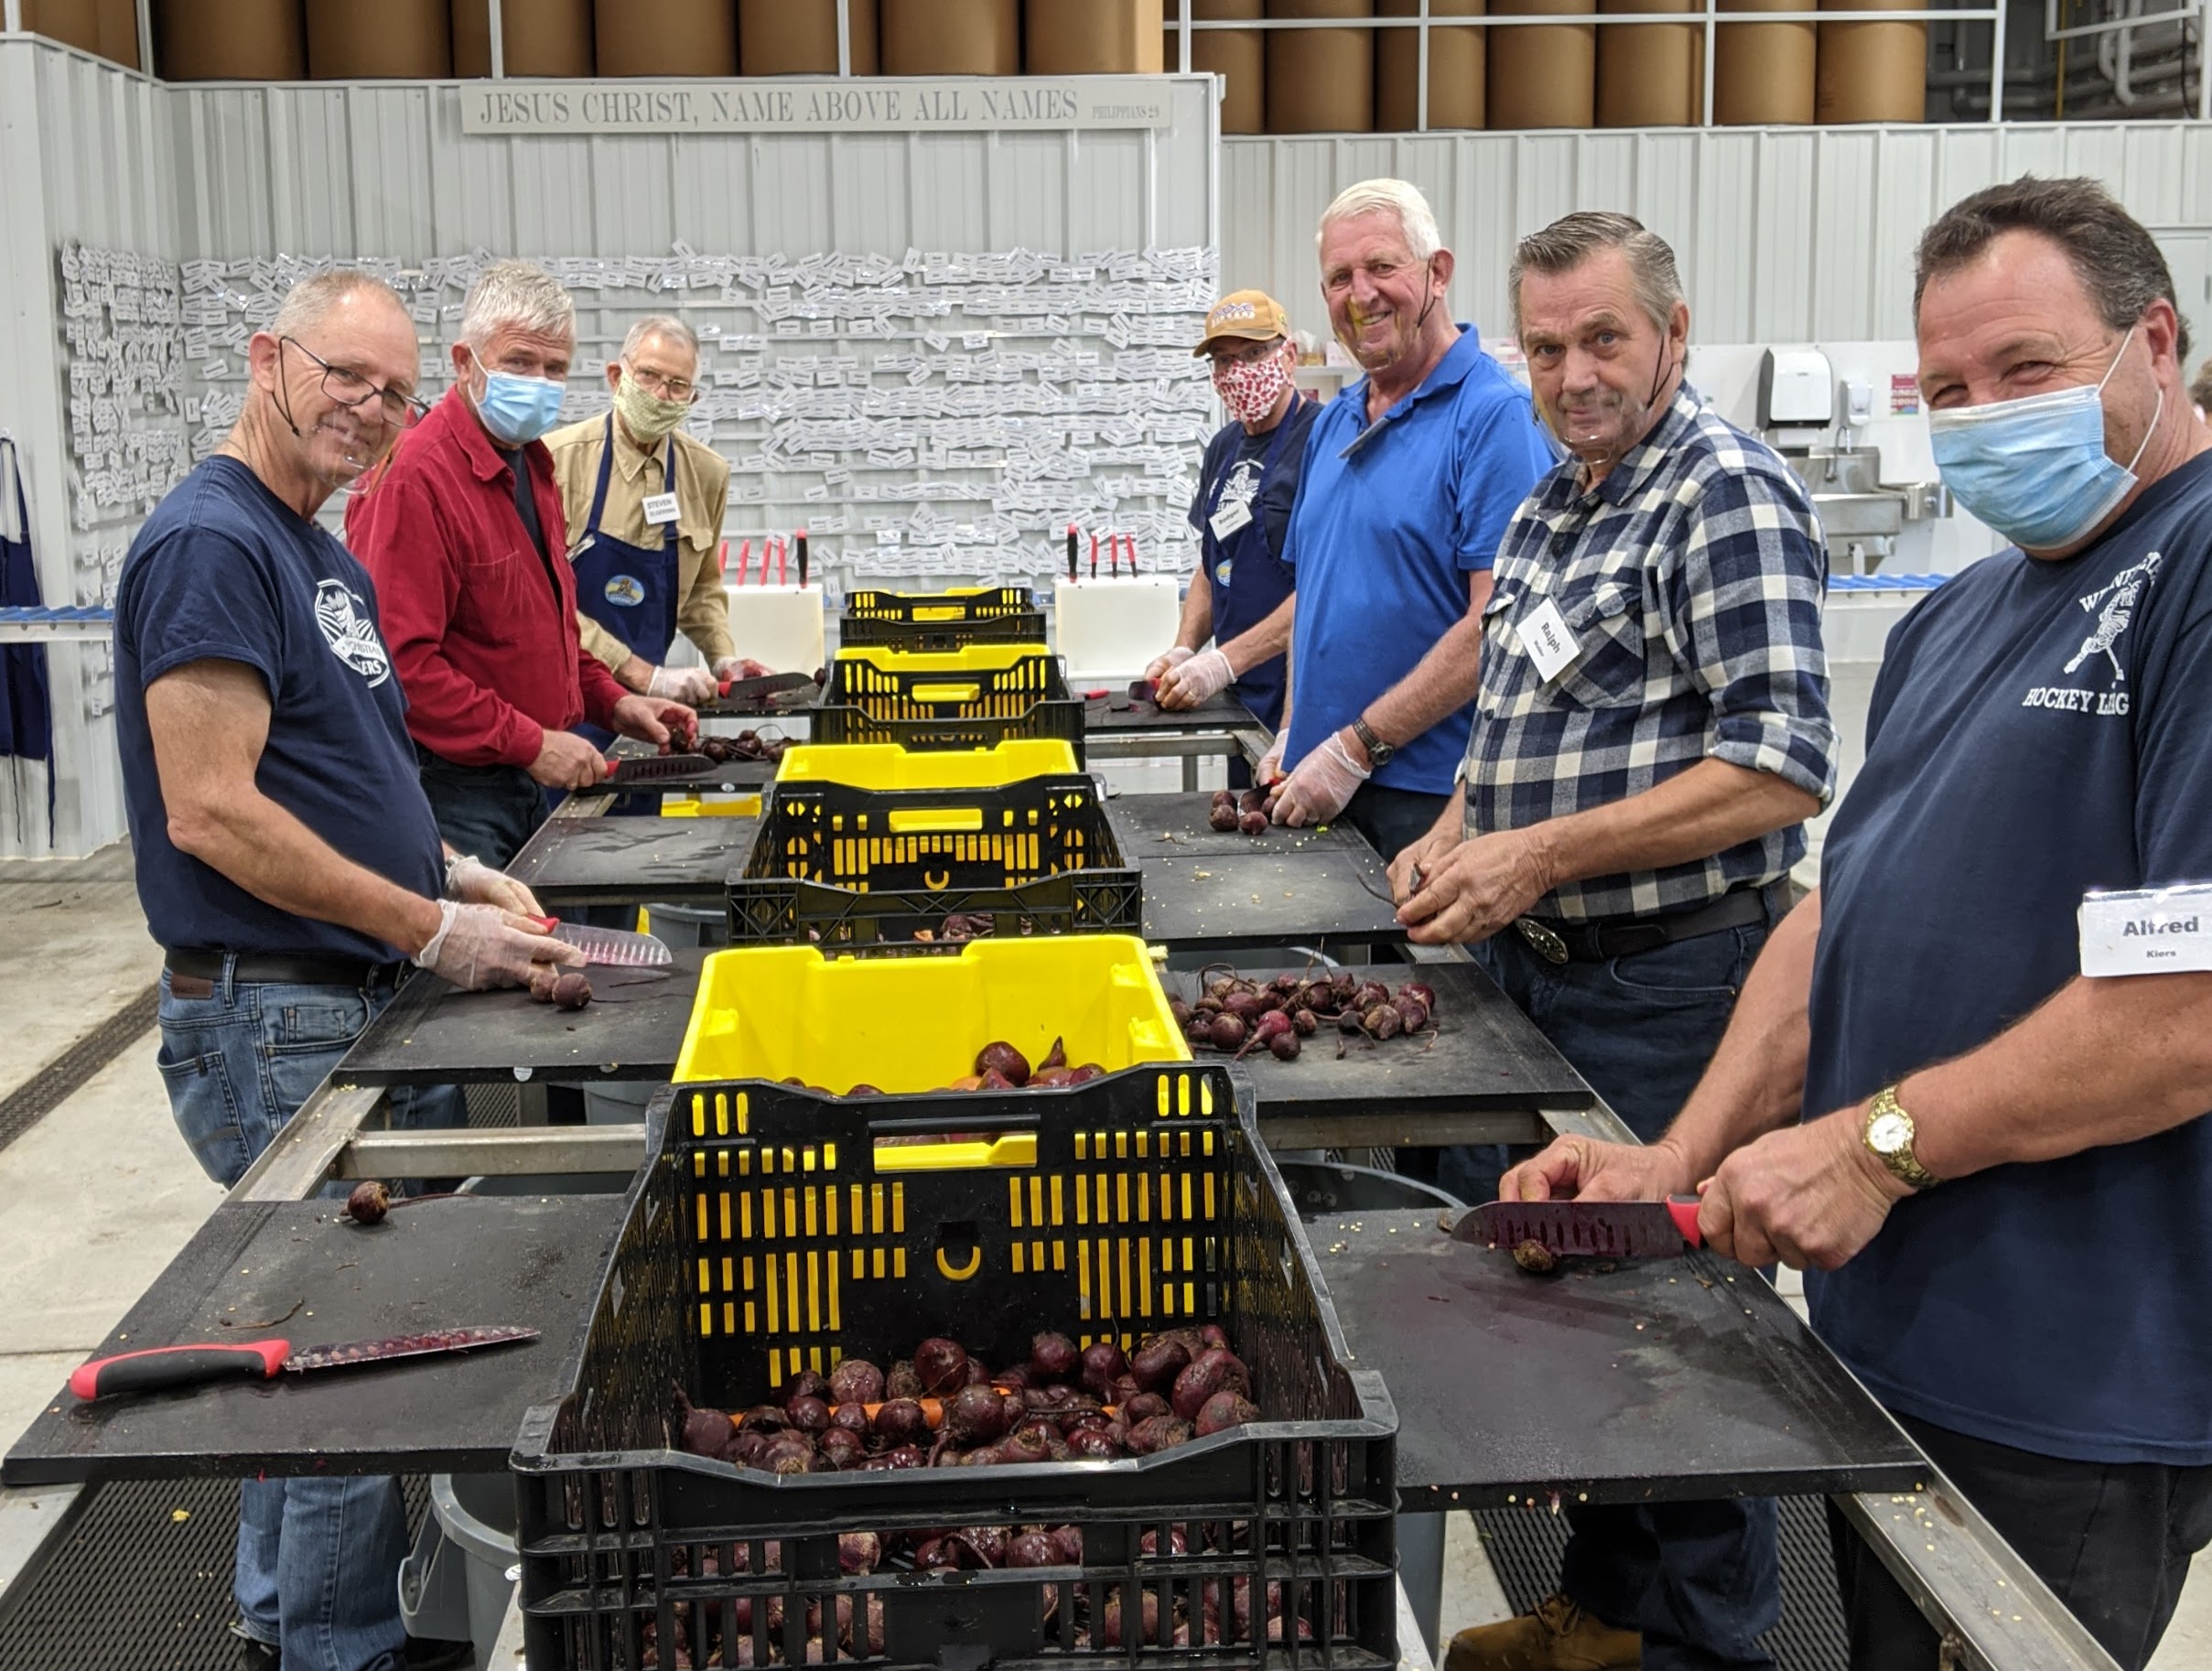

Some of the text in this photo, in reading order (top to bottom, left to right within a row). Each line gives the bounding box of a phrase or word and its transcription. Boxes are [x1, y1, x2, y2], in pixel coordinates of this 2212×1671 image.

[480, 92, 569, 124] JESUS
[582, 92, 699, 126] CHRIST,
[711, 92, 793, 123] NAME
[806, 91, 901, 122] ABOVE
[915, 91, 968, 121] ALL
[980, 90, 1078, 120] NAMES
[1092, 104, 1147, 120] PHILIPPIANS
[647, 499, 672, 509] STEVEN
[1541, 621, 1561, 653] Ralph
[2022, 687, 2095, 713] HOCKEY
[2122, 916, 2199, 936] Alfred
[2146, 950, 2176, 959] Kiers
